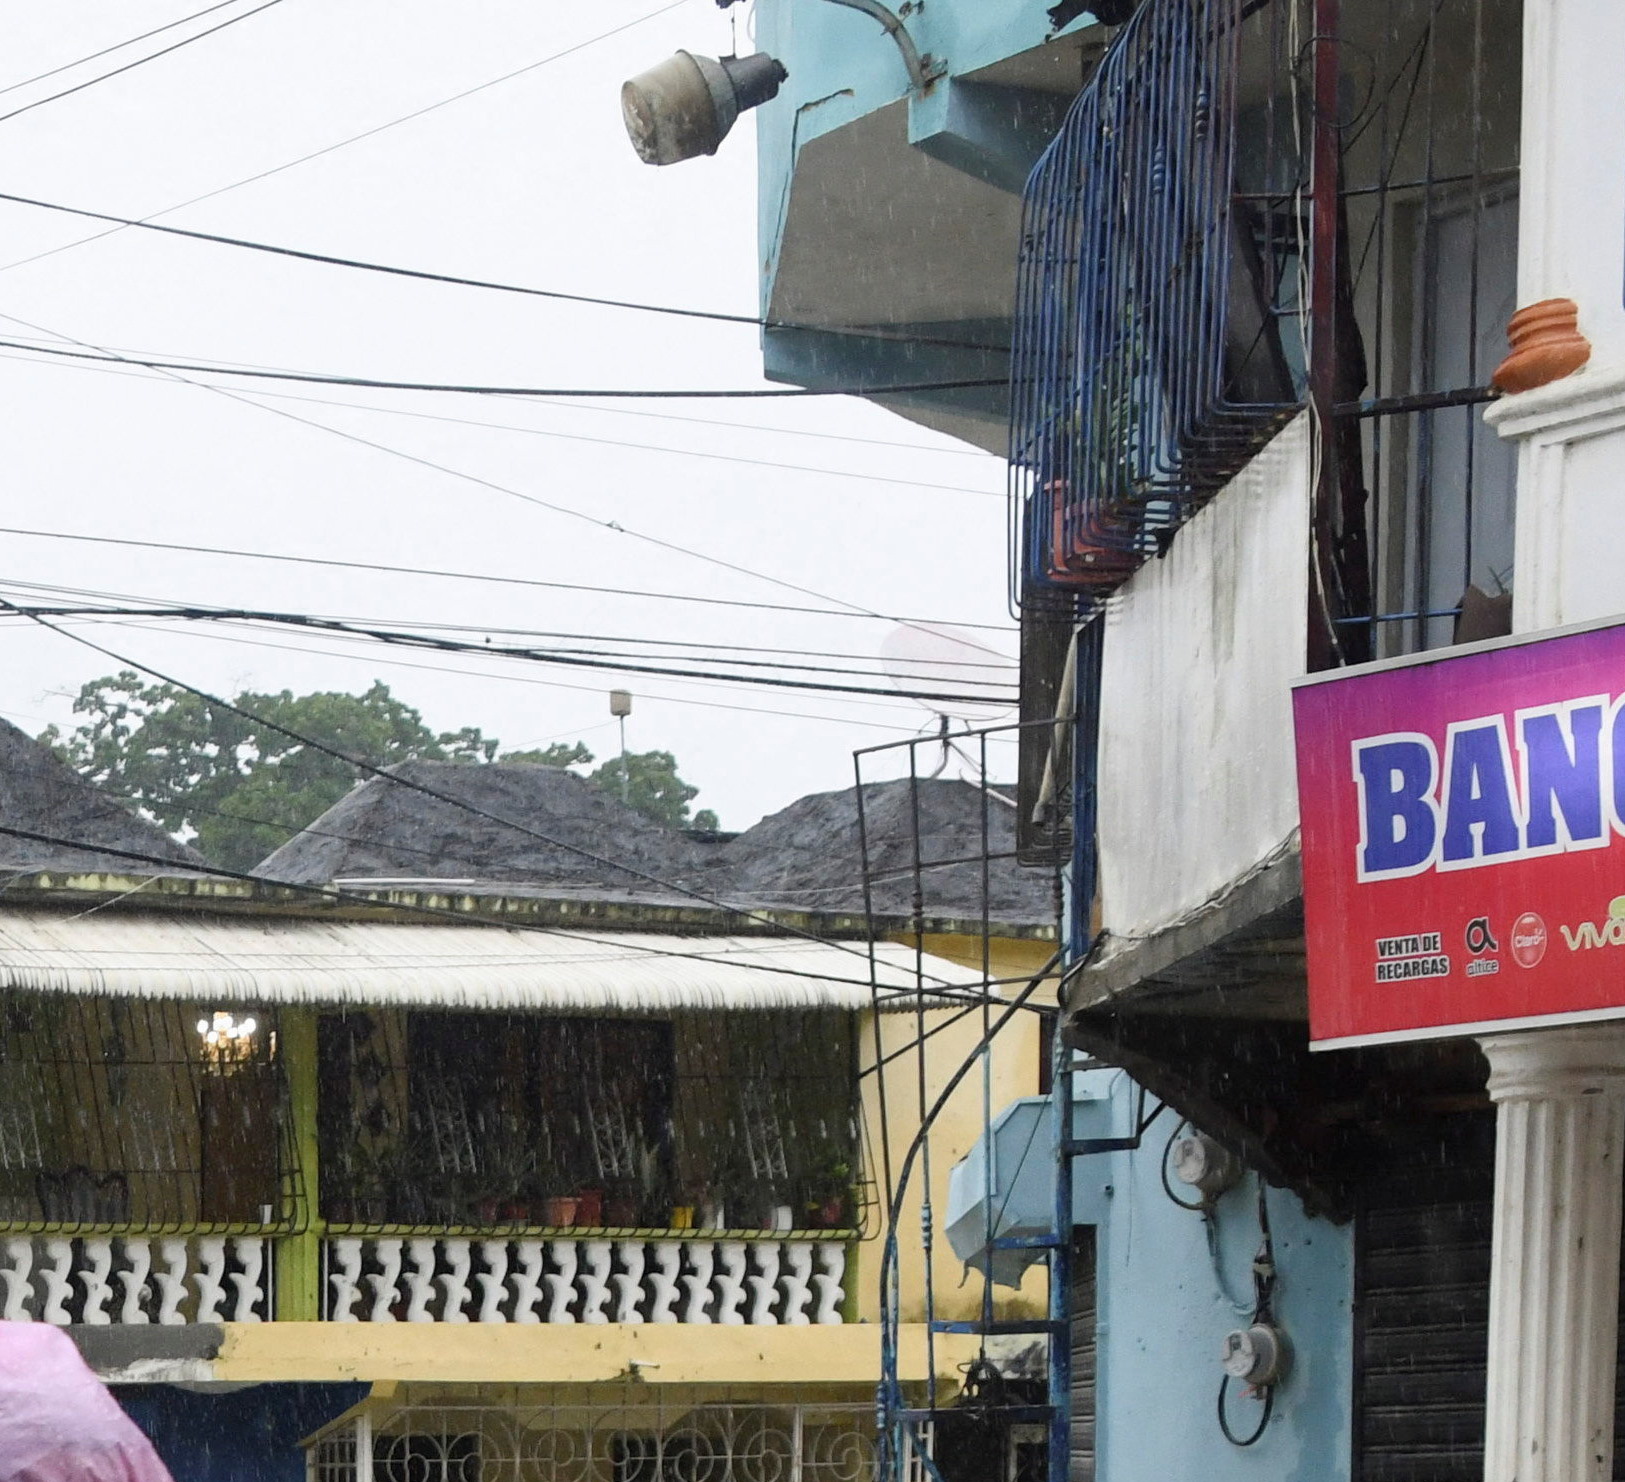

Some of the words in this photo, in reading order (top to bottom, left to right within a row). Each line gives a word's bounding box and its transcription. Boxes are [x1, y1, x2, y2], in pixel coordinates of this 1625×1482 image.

[1377, 936, 1420, 958] VENTA
[1423, 933, 1440, 953] DE
[1377, 957, 1448, 981] RECARGAS
[1467, 959, 1499, 976] altice
